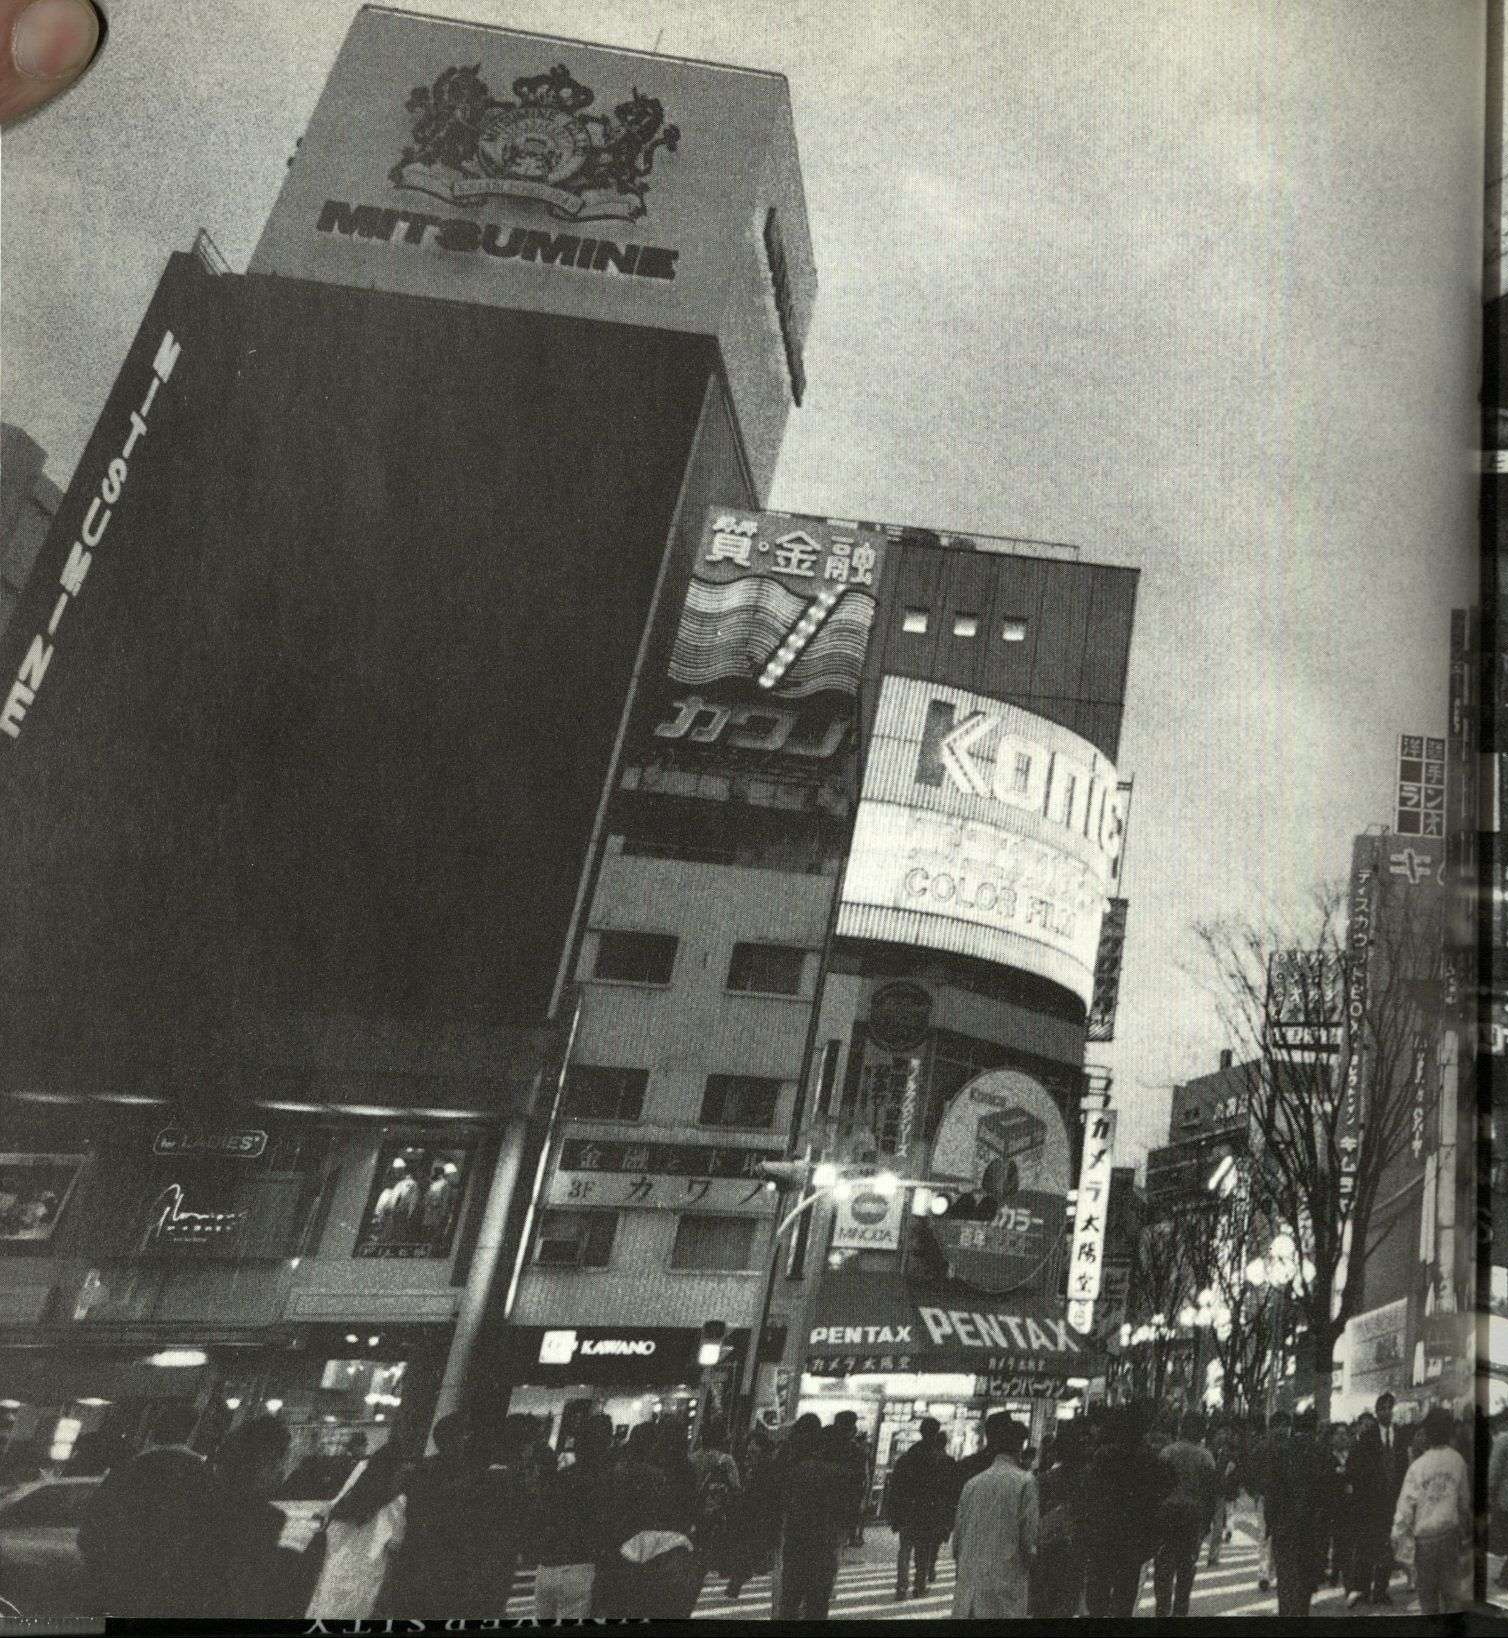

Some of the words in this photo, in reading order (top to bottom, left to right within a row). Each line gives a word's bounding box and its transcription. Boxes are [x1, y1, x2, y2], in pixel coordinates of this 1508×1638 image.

[317, 199, 680, 281] MITSUMINE
[0, 330, 181, 738] MITSUMINE
[904, 867, 1018, 921] COLOR
[568, 1180, 596, 1199] 3F
[627, 1175, 766, 1207] カワノ
[580, 1339, 656, 1356] KAWANO
[810, 1325, 912, 1345] PENTAX
[919, 1306, 1081, 1352] PENTAX
